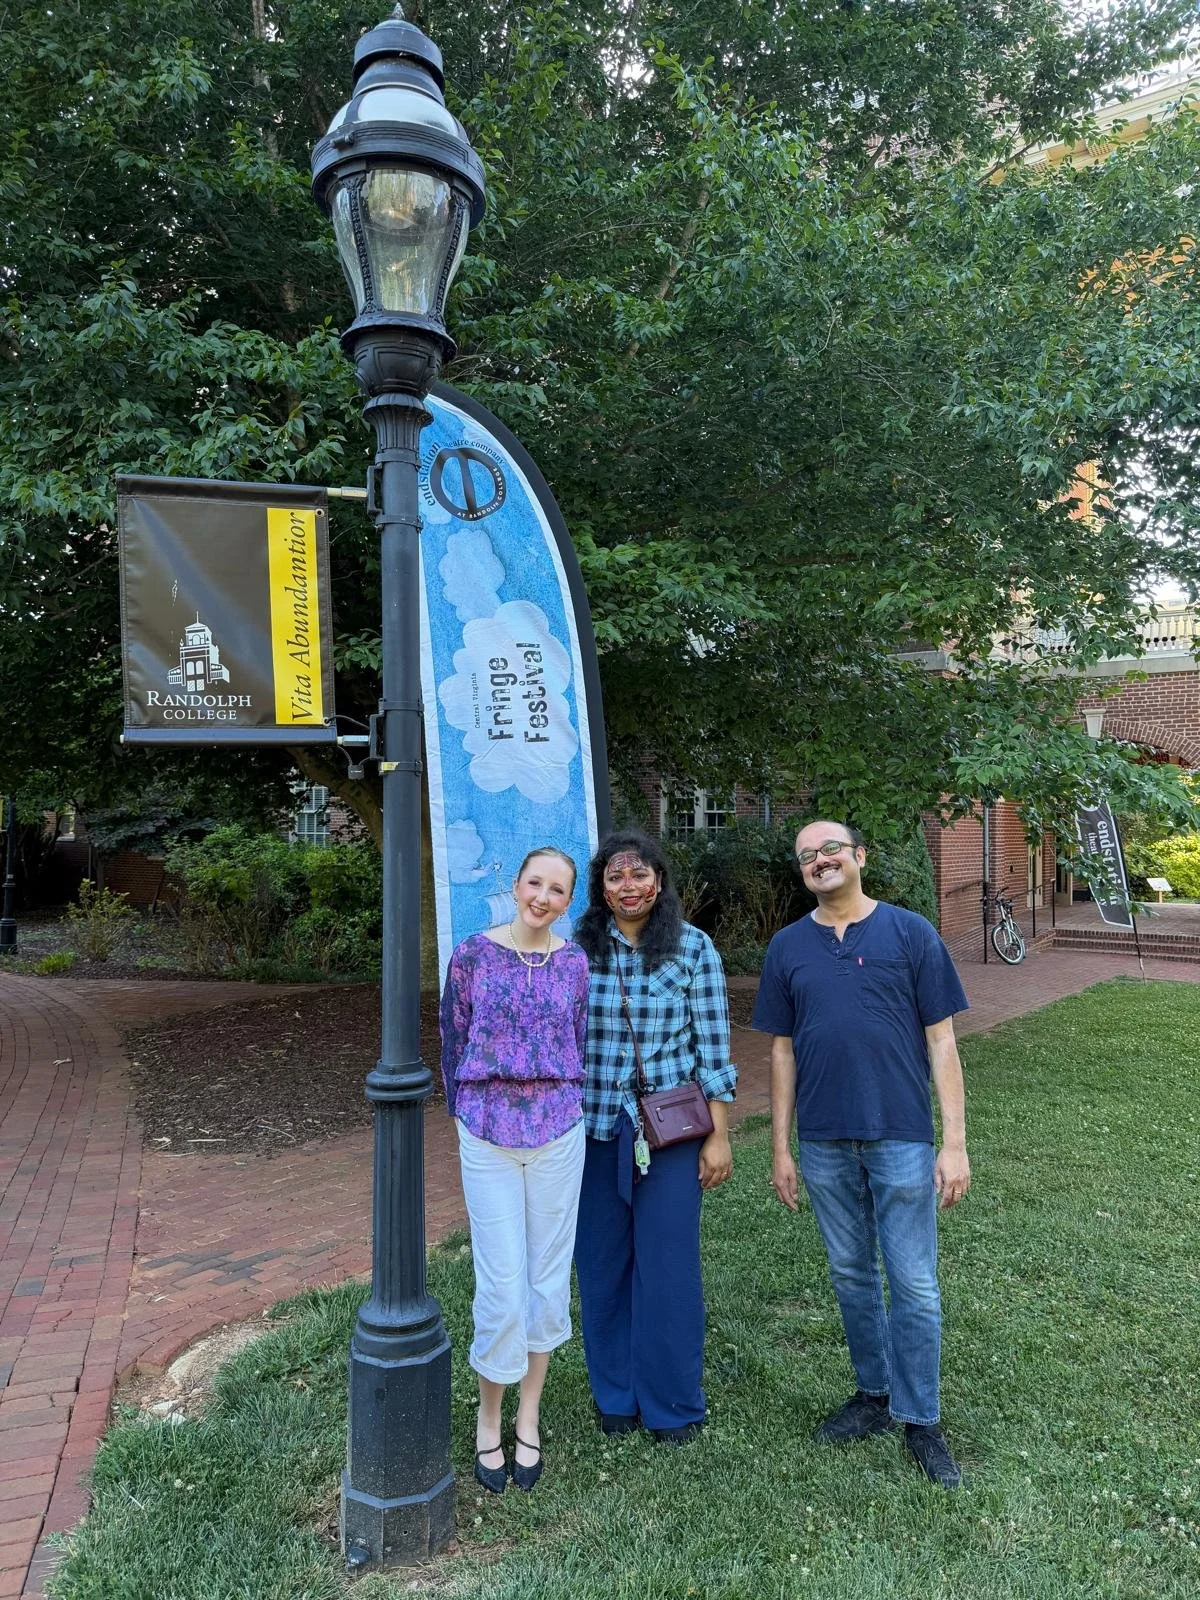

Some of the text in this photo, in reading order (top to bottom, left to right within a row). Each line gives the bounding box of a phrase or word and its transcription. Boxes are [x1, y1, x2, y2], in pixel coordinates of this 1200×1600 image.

[418, 439, 505, 506] endstation eatre company
[493, 467, 503, 500] COLLEGE
[284, 512, 314, 721] Vita Abundantior
[146, 691, 252, 707] RANDOLPH
[472, 672, 481, 701] Virginia
[485, 657, 518, 741] Fringe
[516, 642, 550, 743] Festival
[163, 709, 237, 720] COLLEGE
